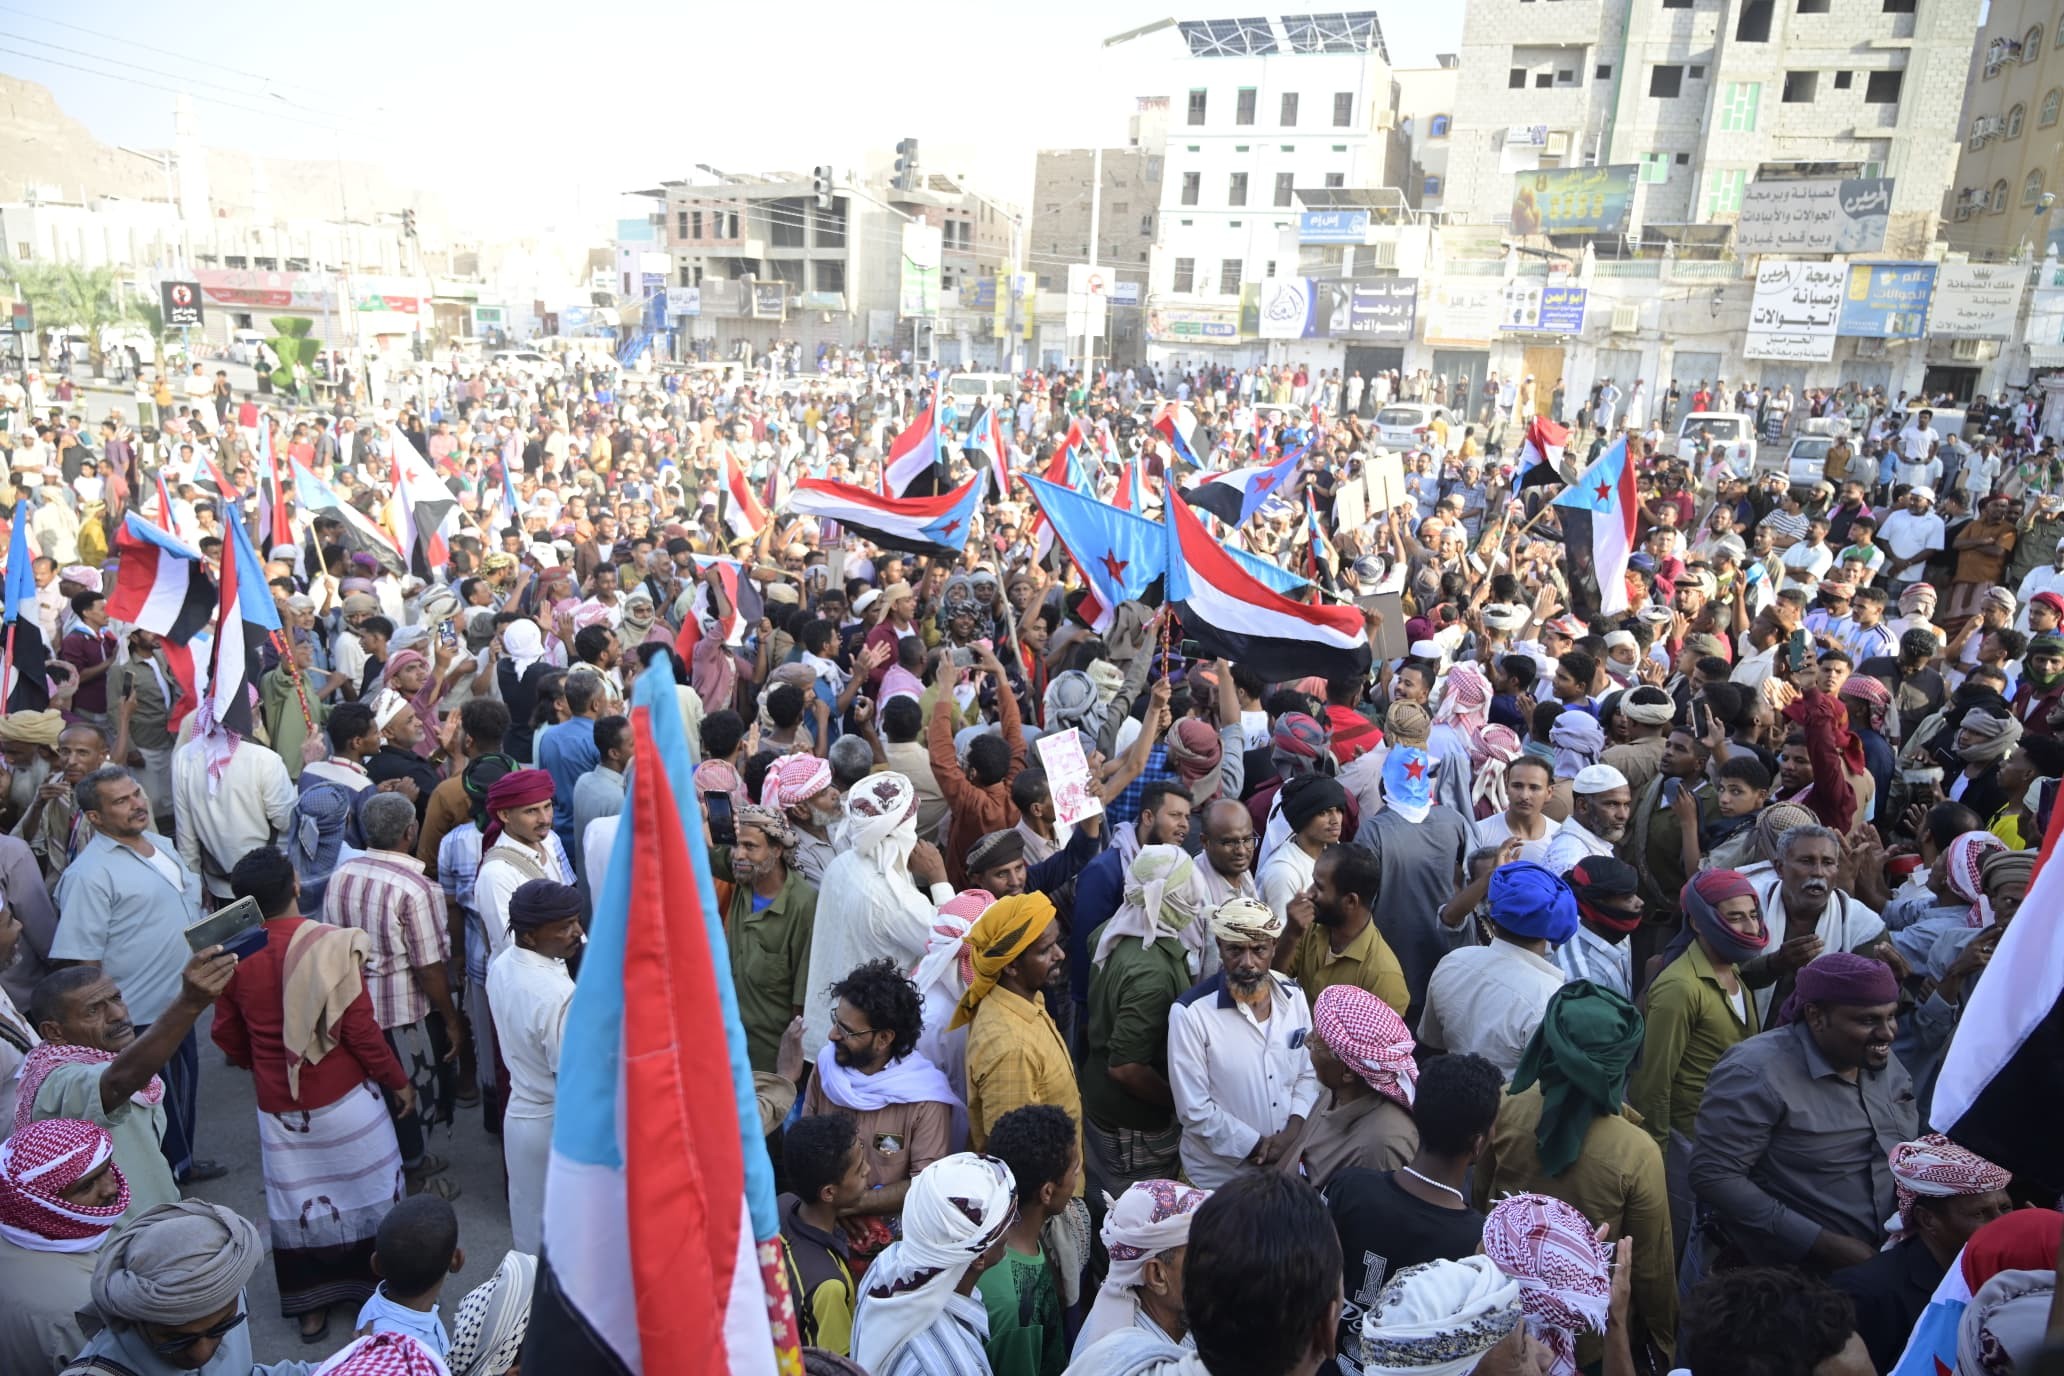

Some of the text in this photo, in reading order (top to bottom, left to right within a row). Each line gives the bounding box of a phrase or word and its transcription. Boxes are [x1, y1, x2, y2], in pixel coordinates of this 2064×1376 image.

[1745, 186, 1836, 203] لصيانة وبرمجة
[1792, 209, 1836, 224] الجوالات
[1805, 266, 1843, 288] برمجة
[1792, 287, 1840, 310] وصيانة
[1352, 319, 1412, 334] الجوالات
[1754, 307, 1837, 331] الجوالات
